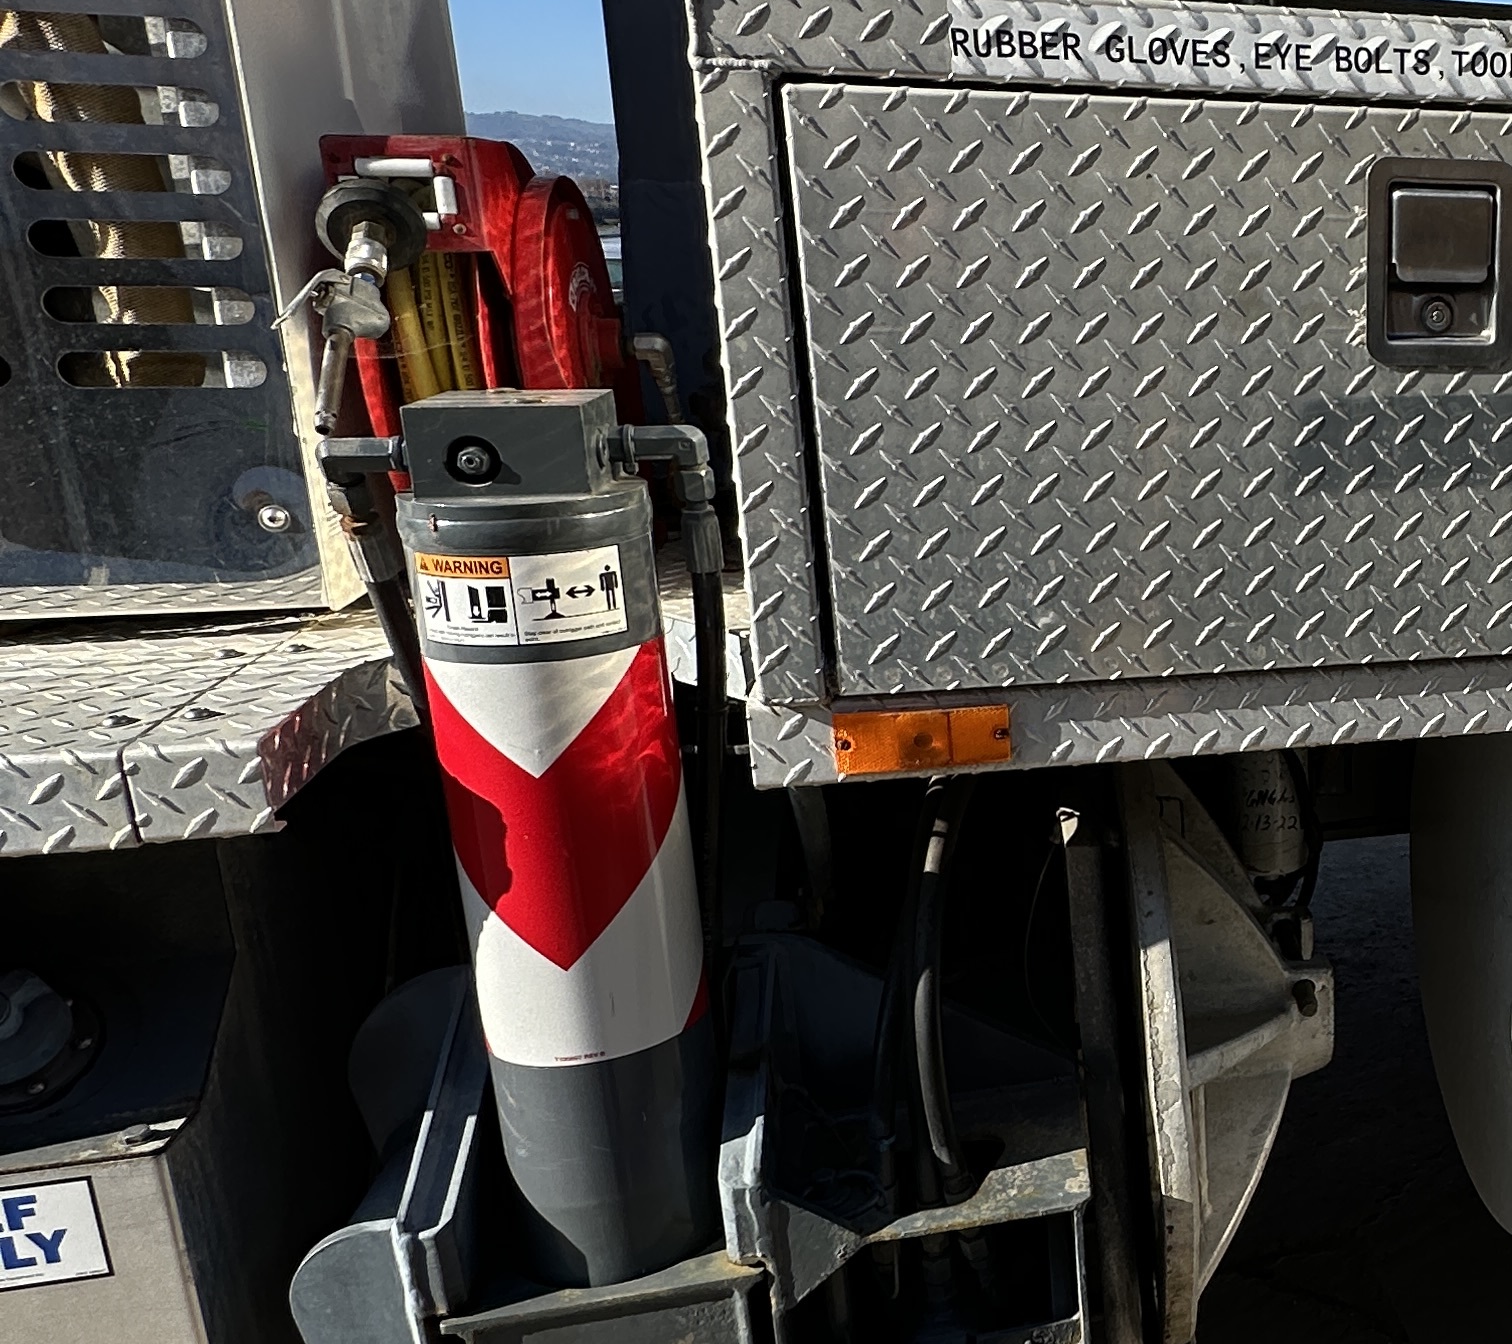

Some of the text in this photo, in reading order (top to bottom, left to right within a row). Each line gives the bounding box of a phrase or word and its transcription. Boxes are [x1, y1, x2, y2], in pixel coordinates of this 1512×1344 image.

[950, 27, 1083, 61] RUBBER
[432, 557, 504, 575] WARNING
[0, 1195, 37, 1233] F
